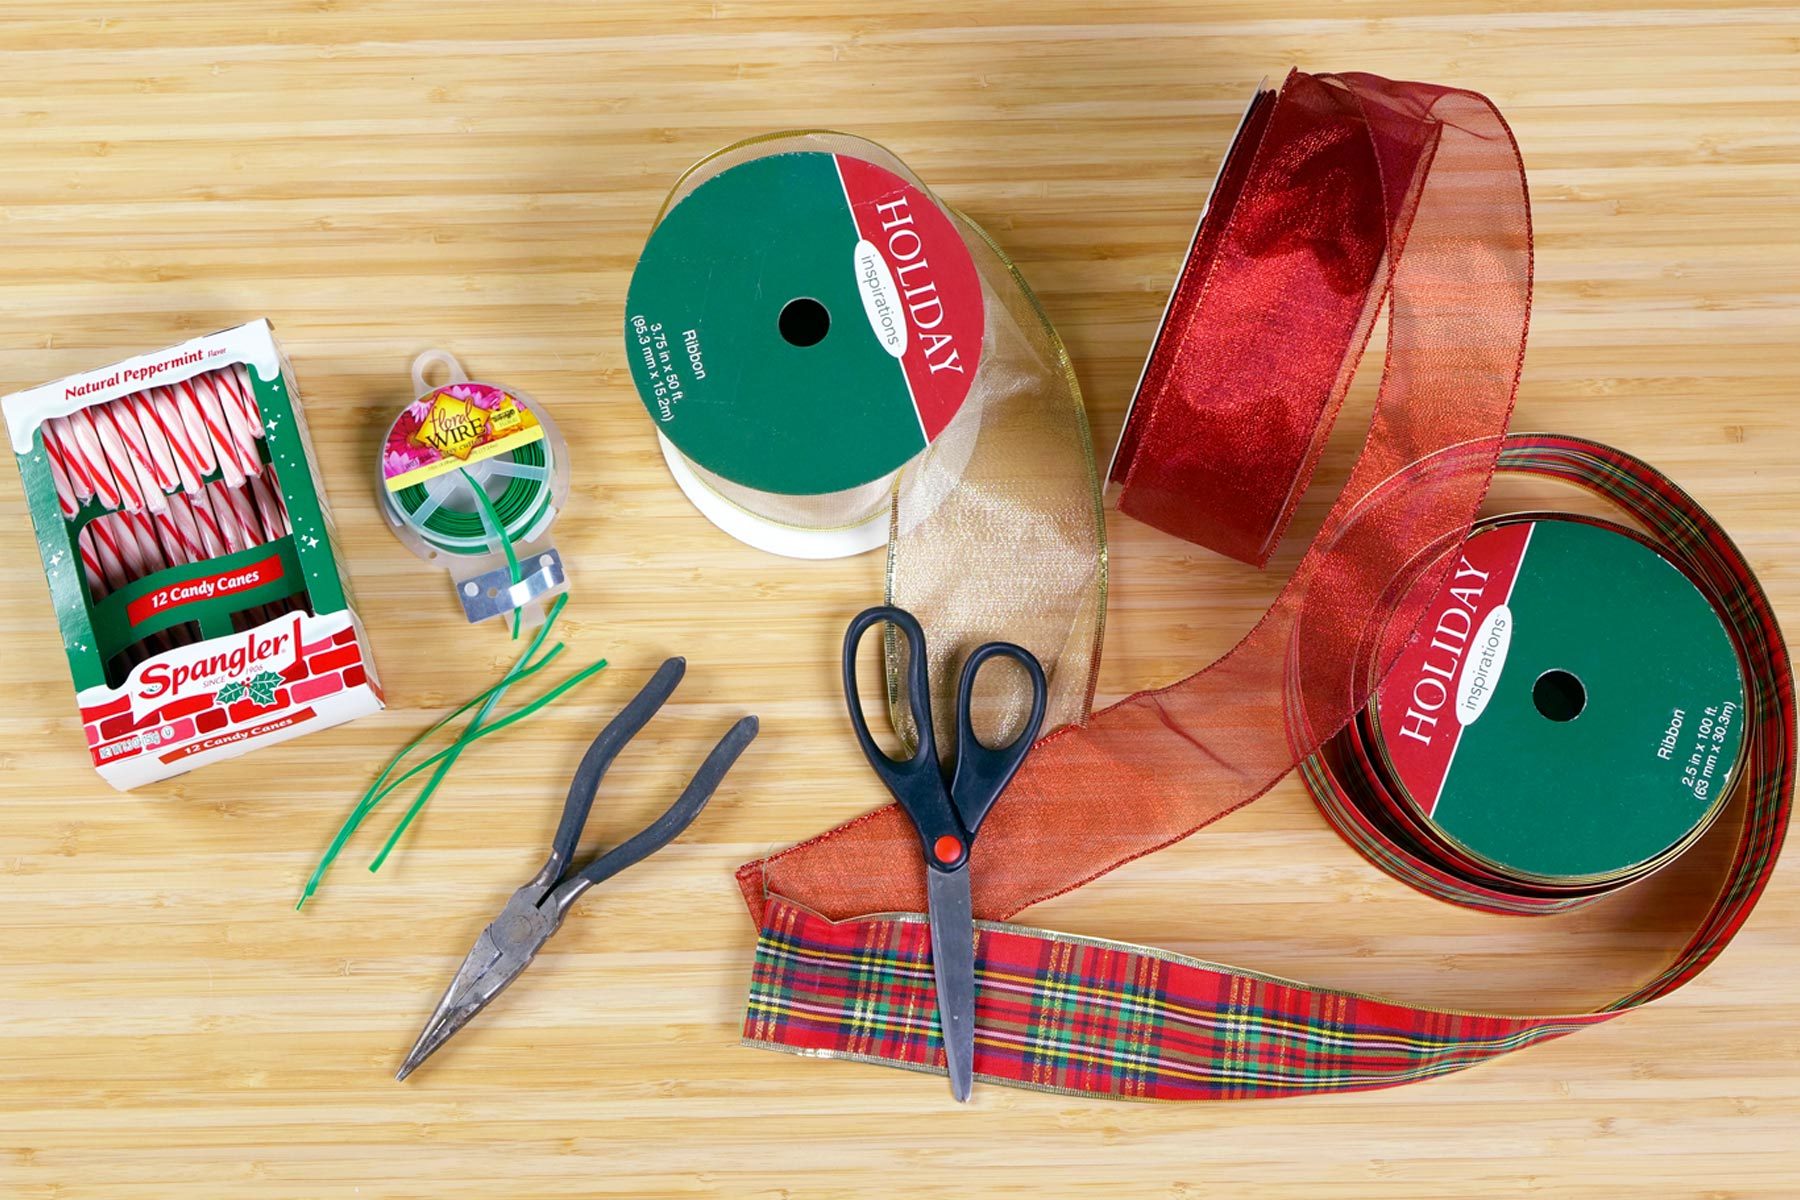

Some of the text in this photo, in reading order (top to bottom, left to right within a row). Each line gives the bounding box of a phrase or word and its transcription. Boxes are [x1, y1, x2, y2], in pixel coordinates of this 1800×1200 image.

[861, 253, 898, 346] inspirations
[875, 195, 964, 375] HOLIDAY
[65, 373, 120, 400] Natural
[124, 349, 204, 382] Peppermint
[630, 315, 675, 422] (95.3 mm x 15.2m)
[650, 323, 684, 404] 3.75 in x 50 ft.
[682, 329, 706, 380] Ribbon
[426, 418, 486, 450] WIRE
[151, 570, 260, 608] 12 Candy Canes
[138, 633, 289, 699] Spangler
[202, 664, 263, 688] SINCE 1906
[1399, 555, 1489, 747] HOLIDAY
[1461, 617, 1506, 711] inspirations
[184, 718, 293, 754] 12 Candy Canes
[1657, 708, 1686, 760] Ribbon
[1682, 706, 1718, 788] 2.5 in x 100 ft.
[1693, 701, 1737, 800] (63 mm x 30.3m)
